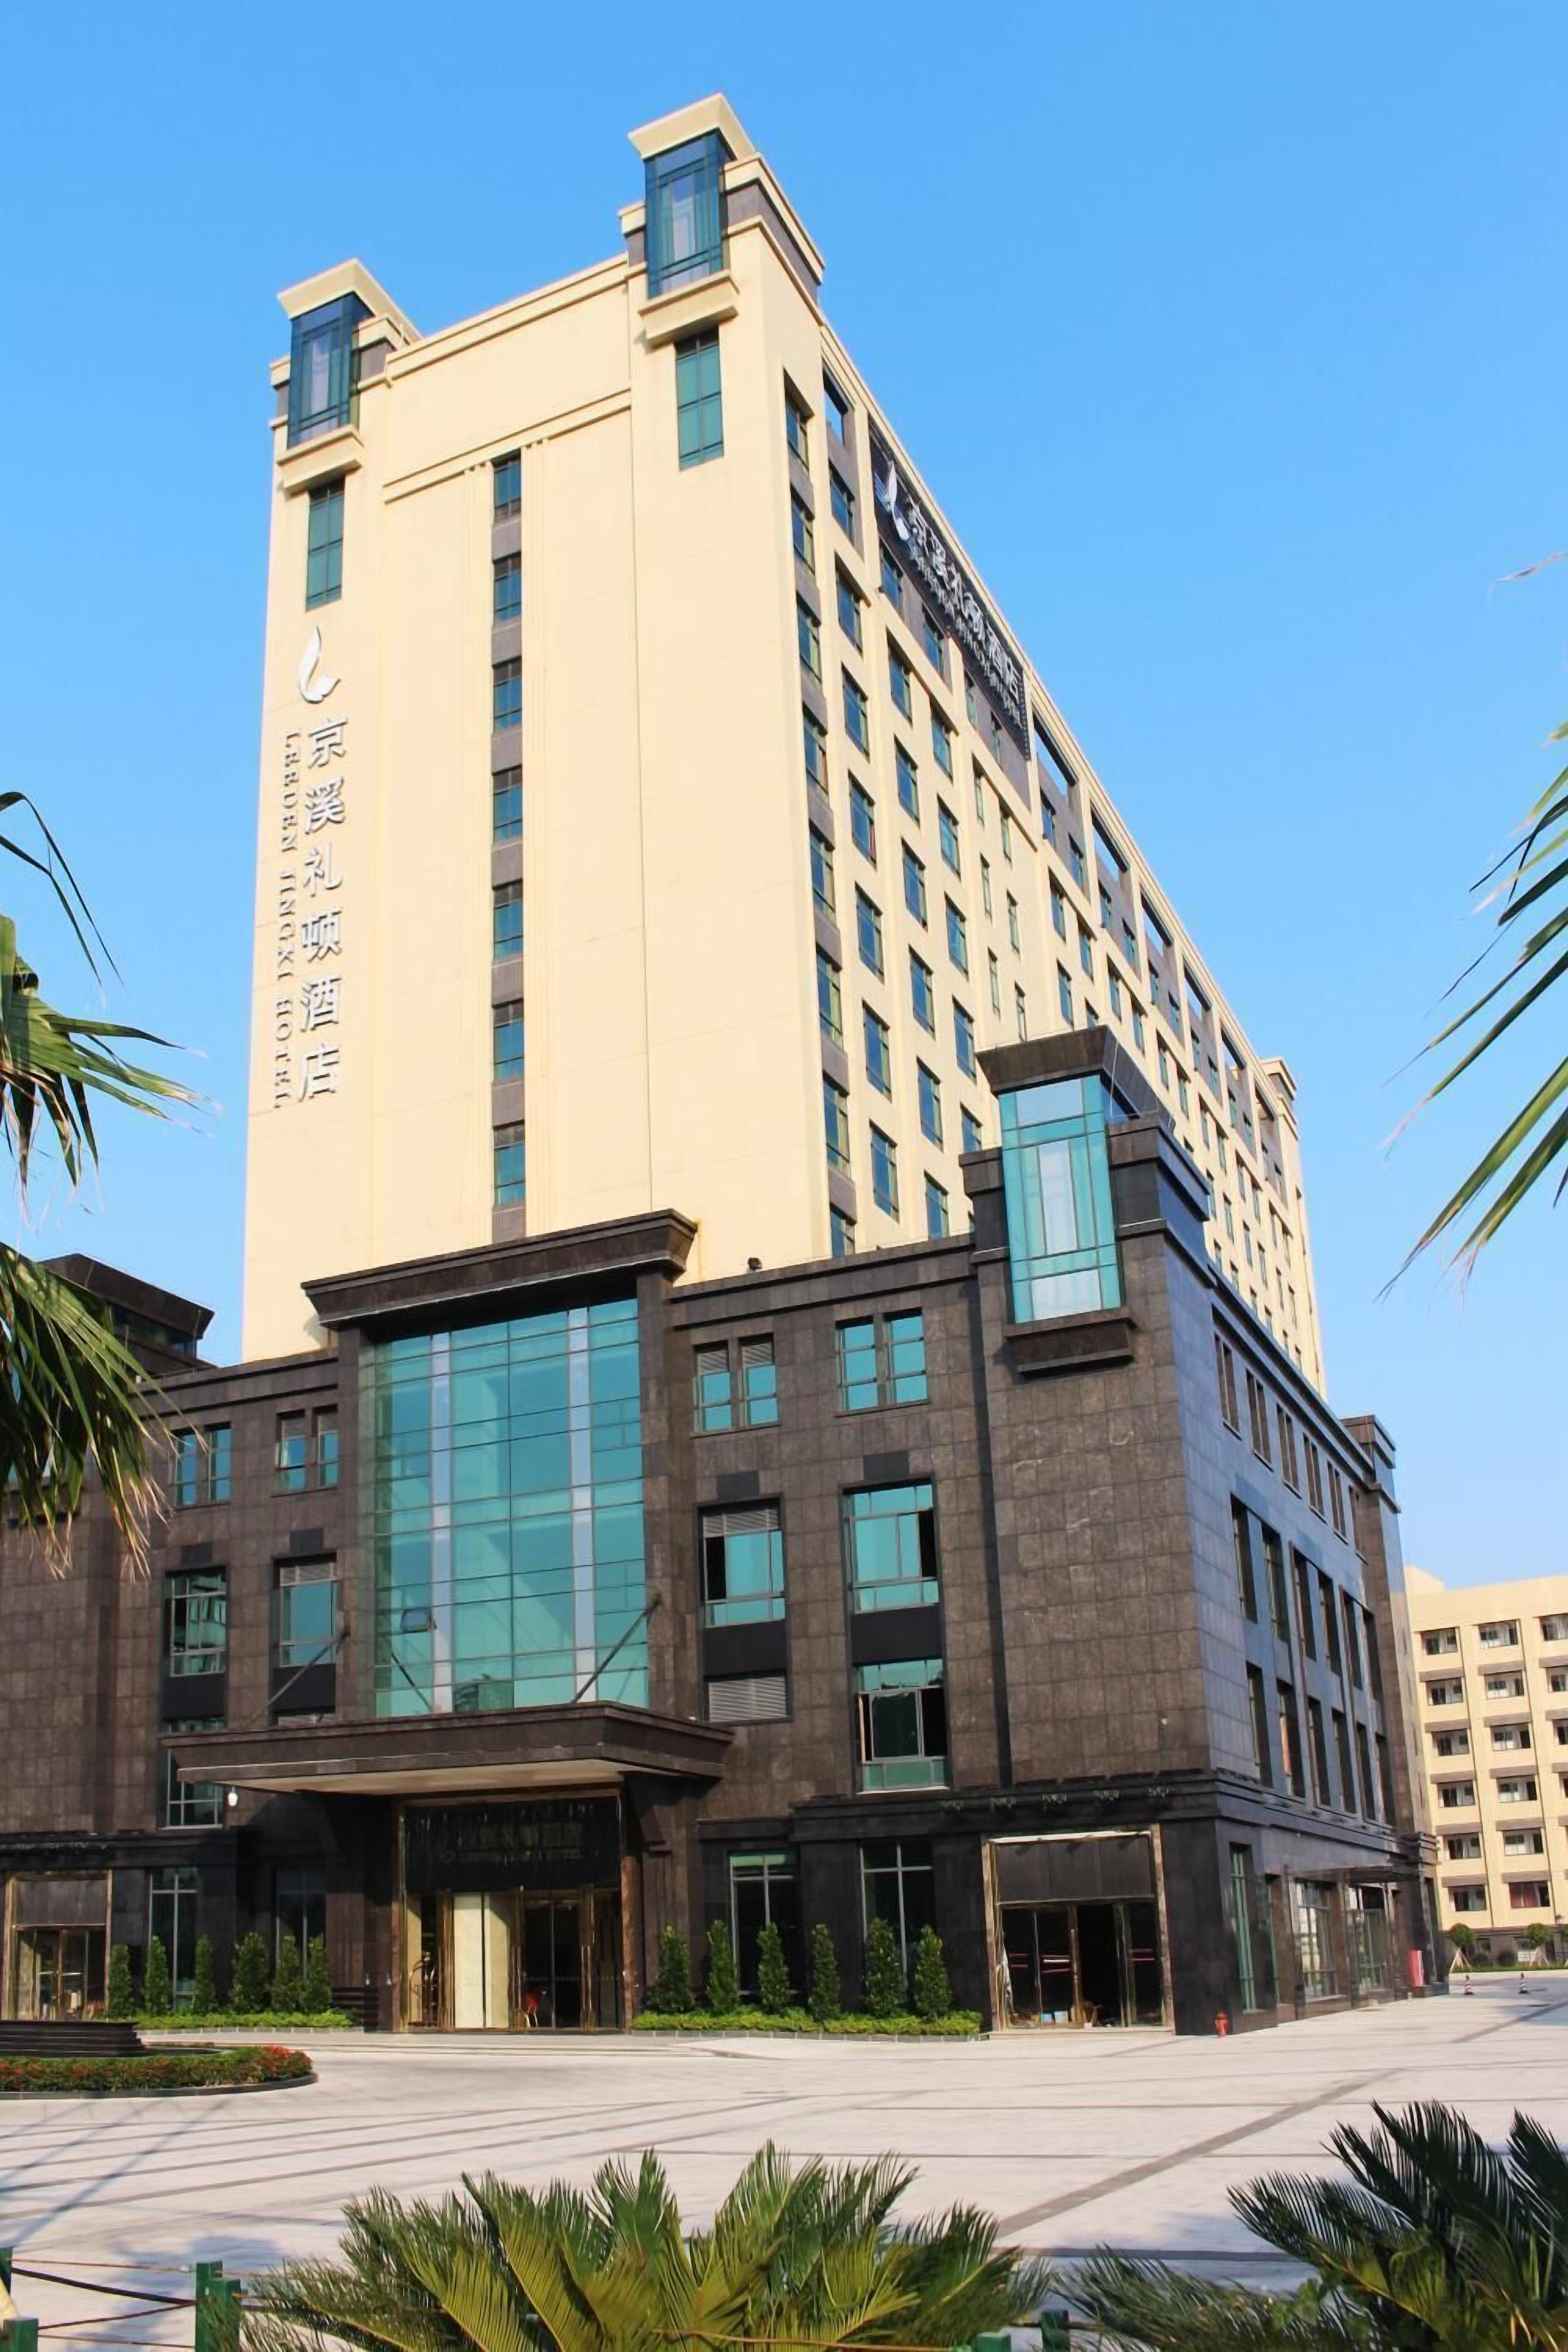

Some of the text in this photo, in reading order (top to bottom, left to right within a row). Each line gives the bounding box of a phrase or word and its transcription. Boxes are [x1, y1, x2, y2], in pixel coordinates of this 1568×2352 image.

[274, 728, 301, 1109] LEEDEN JINGXI HOTEL
[298, 717, 348, 1103] 京溪礼顿酒店
